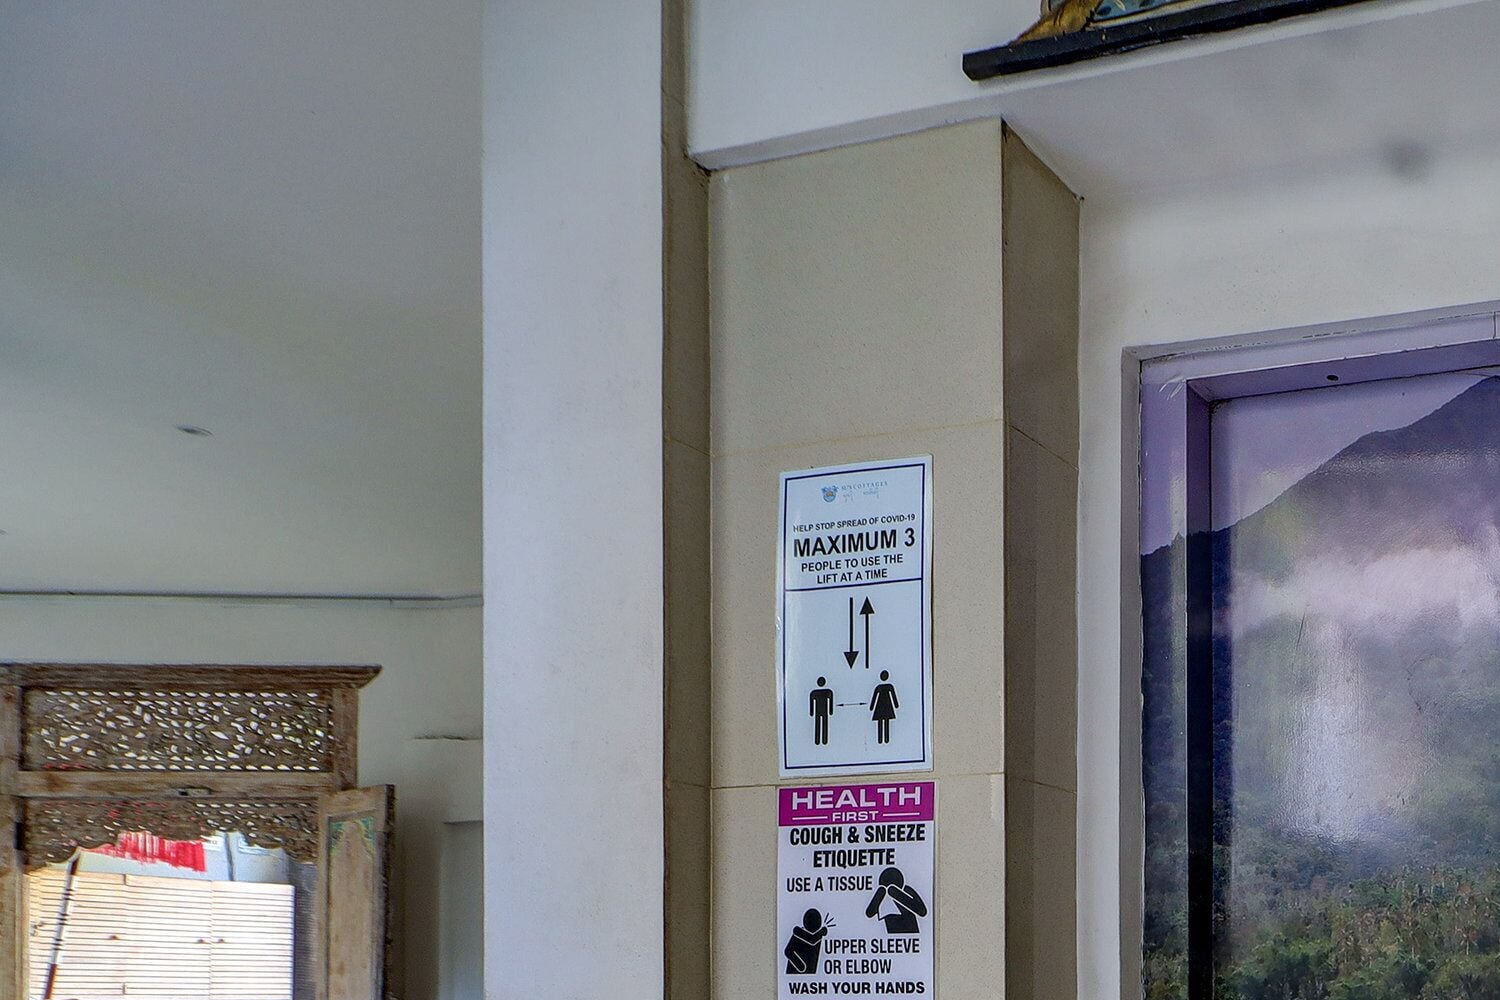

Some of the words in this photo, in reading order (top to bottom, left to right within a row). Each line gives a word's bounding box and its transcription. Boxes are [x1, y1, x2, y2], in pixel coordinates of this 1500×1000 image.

[793, 524, 814, 532] HELP
[815, 522, 835, 531] STOP
[837, 518, 867, 529] SPREAD
[869, 517, 880, 525] OF
[881, 513, 916, 524] COVID-19
[794, 529, 897, 558] MAXIMUM
[904, 527, 916, 547] 3
[801, 560, 841, 572] PEOPLE
[845, 558, 859, 568] TO
[861, 556, 880, 567] USE
[883, 553, 904, 564] THE
[817, 573, 838, 584] LIFT
[840, 572, 853, 582] AT
[855, 571, 863, 581] A
[865, 568, 888, 579] TIME
[792, 786, 921, 810] HEALTH
[832, 811, 879, 822] FIRST
[790, 826, 842, 845] COUGH
[847, 826, 860, 844] &
[864, 823, 926, 843] SNEEZE
[813, 848, 895, 869] ETIQUETTE
[786, 877, 811, 892] USE
[814, 877, 824, 891] A
[827, 875, 873, 891] TISSUE
[824, 938, 867, 954] UPPER
[870, 938, 920, 954] SLEEVE
[824, 959, 842, 974] OR
[846, 959, 892, 974] ELBOW
[788, 982, 828, 994] WASH
[832, 982, 871, 994] YOUR
[875, 981, 925, 994] HANDS
